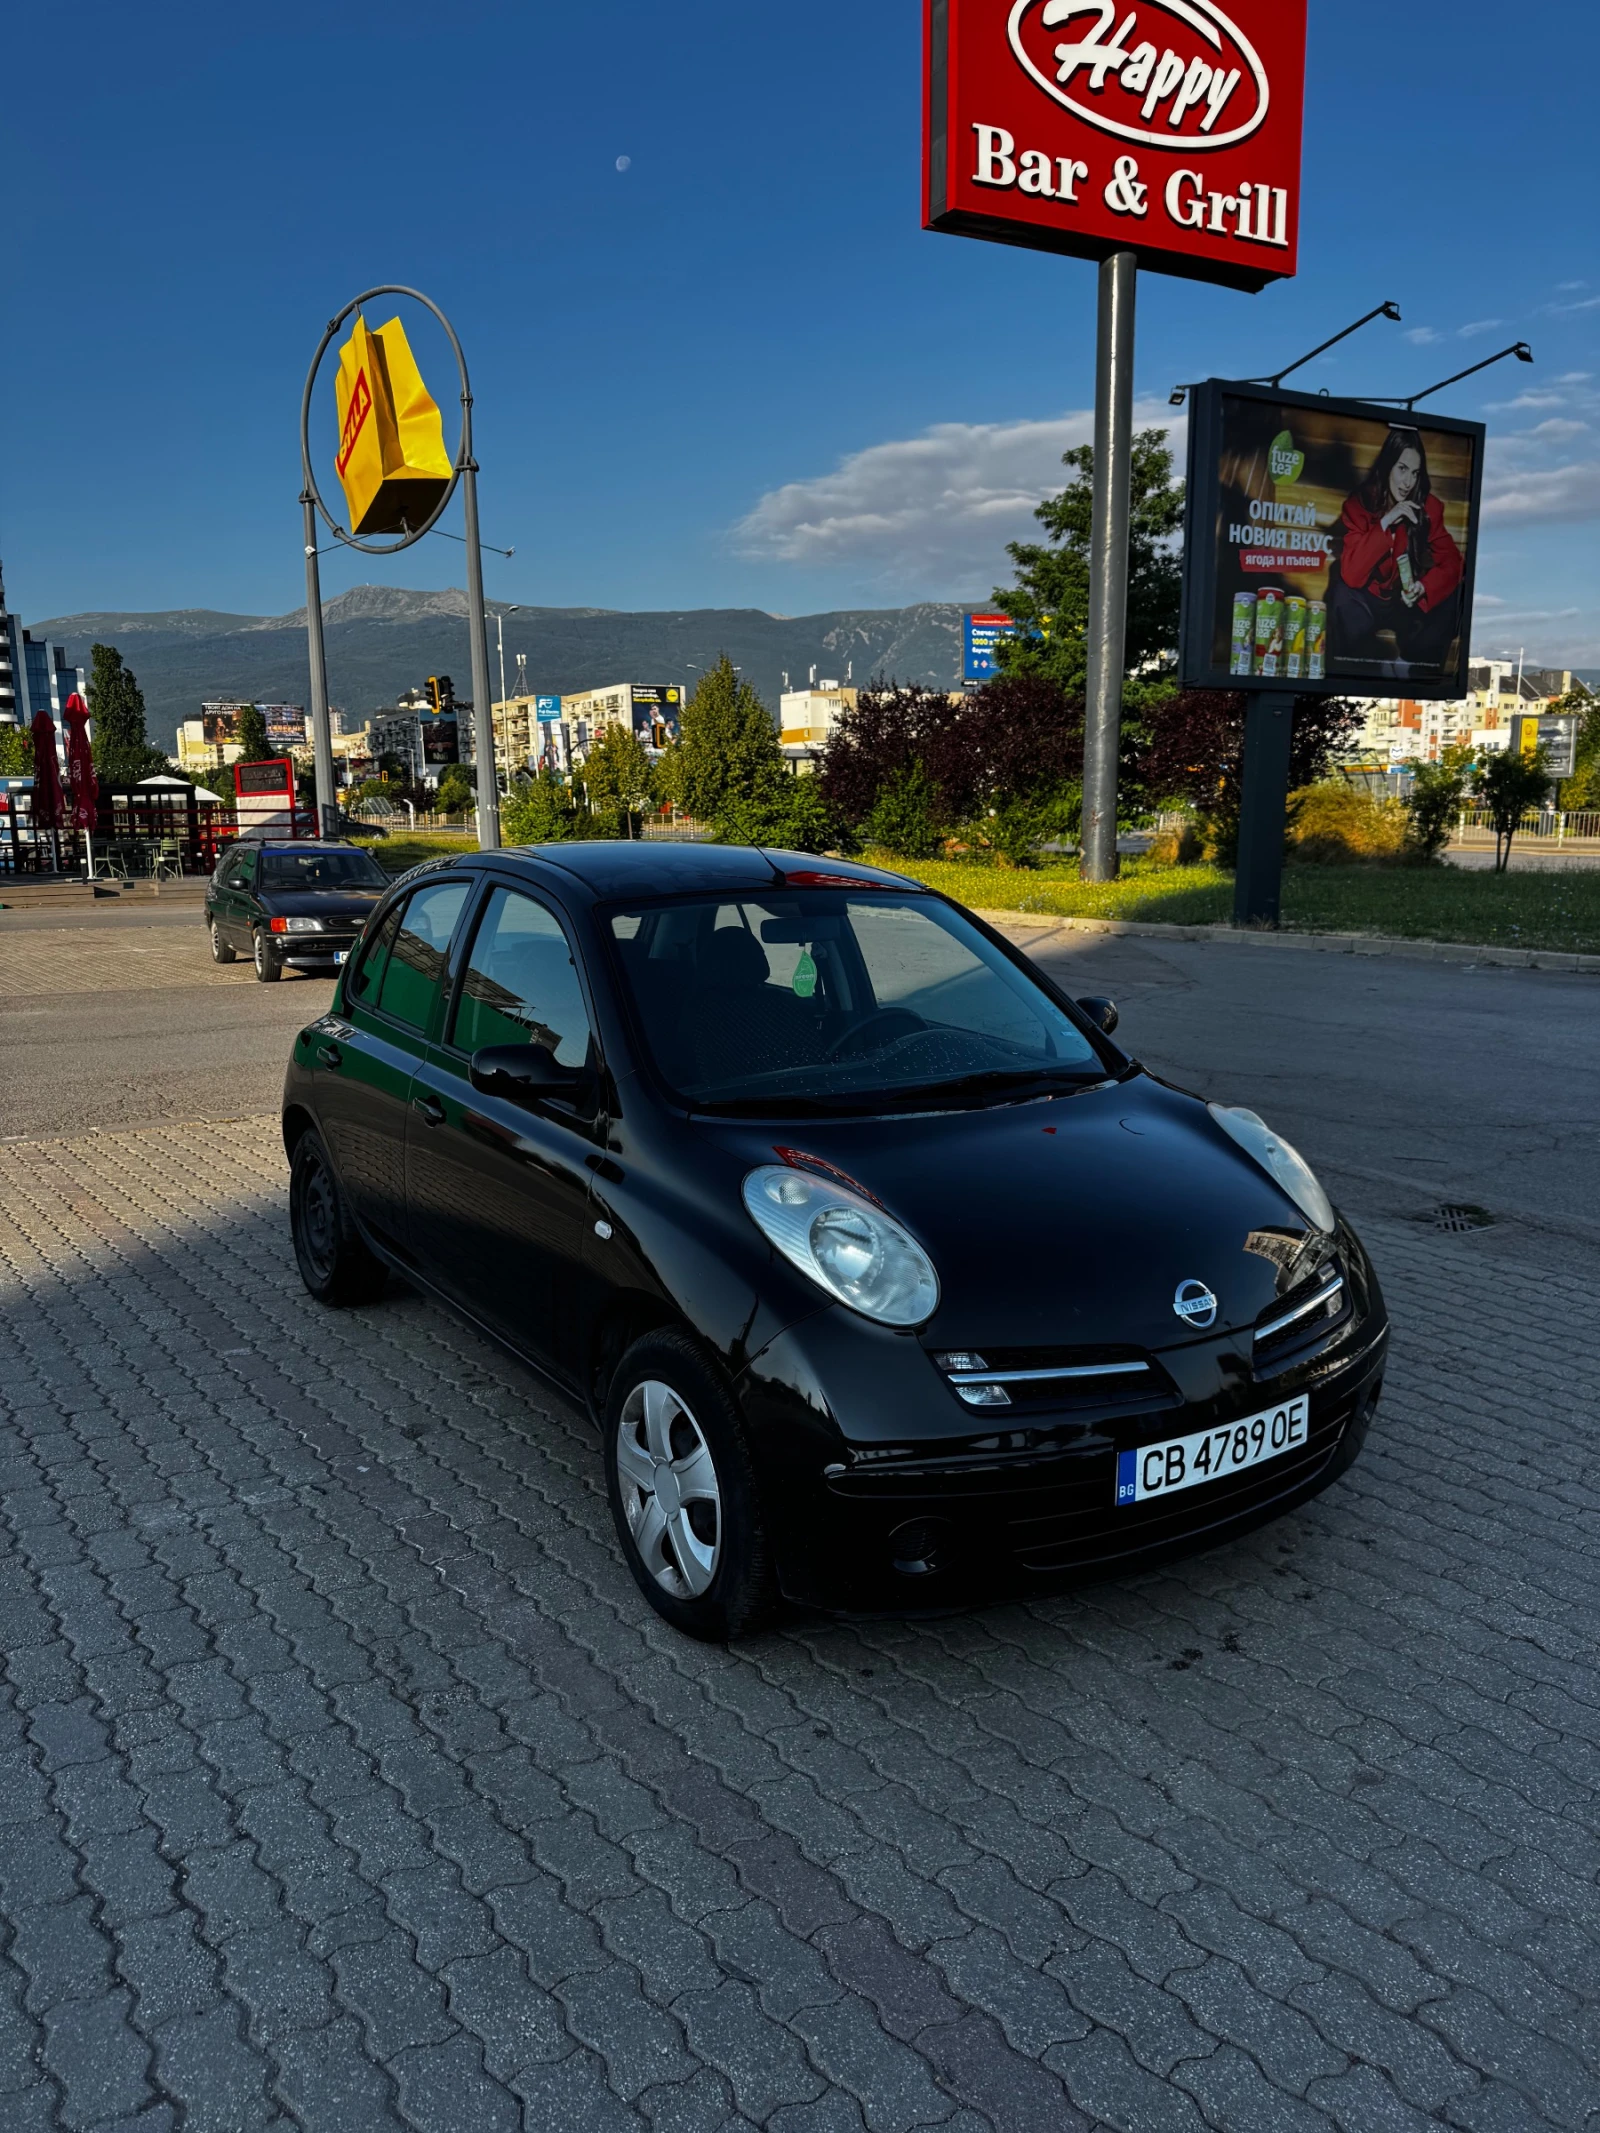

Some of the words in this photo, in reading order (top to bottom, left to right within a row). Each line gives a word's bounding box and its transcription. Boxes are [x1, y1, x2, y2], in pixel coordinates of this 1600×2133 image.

[1043, 0, 1241, 131] Happy
[971, 122, 1088, 201] Bar
[1104, 155, 1148, 215] &
[1165, 169, 1289, 247] Grill
[1272, 445, 1300, 465] fuze
[1272, 462, 1292, 476] tea
[1249, 499, 1317, 527] ОПИТАЙ
[1229, 523, 1288, 549] НОВИЯ
[1290, 531, 1334, 555] ВКУС
[1245, 554, 1275, 568] ягода
[1277, 556, 1284, 566] и
[1286, 556, 1320, 567] пъпеш
[1180, 1297, 1215, 1312] NISSAN
[1142, 1444, 1186, 1491] CB
[1193, 1419, 1266, 1475] 4789
[1271, 1401, 1304, 1449] OE
[1119, 1483, 1135, 1498] BG
